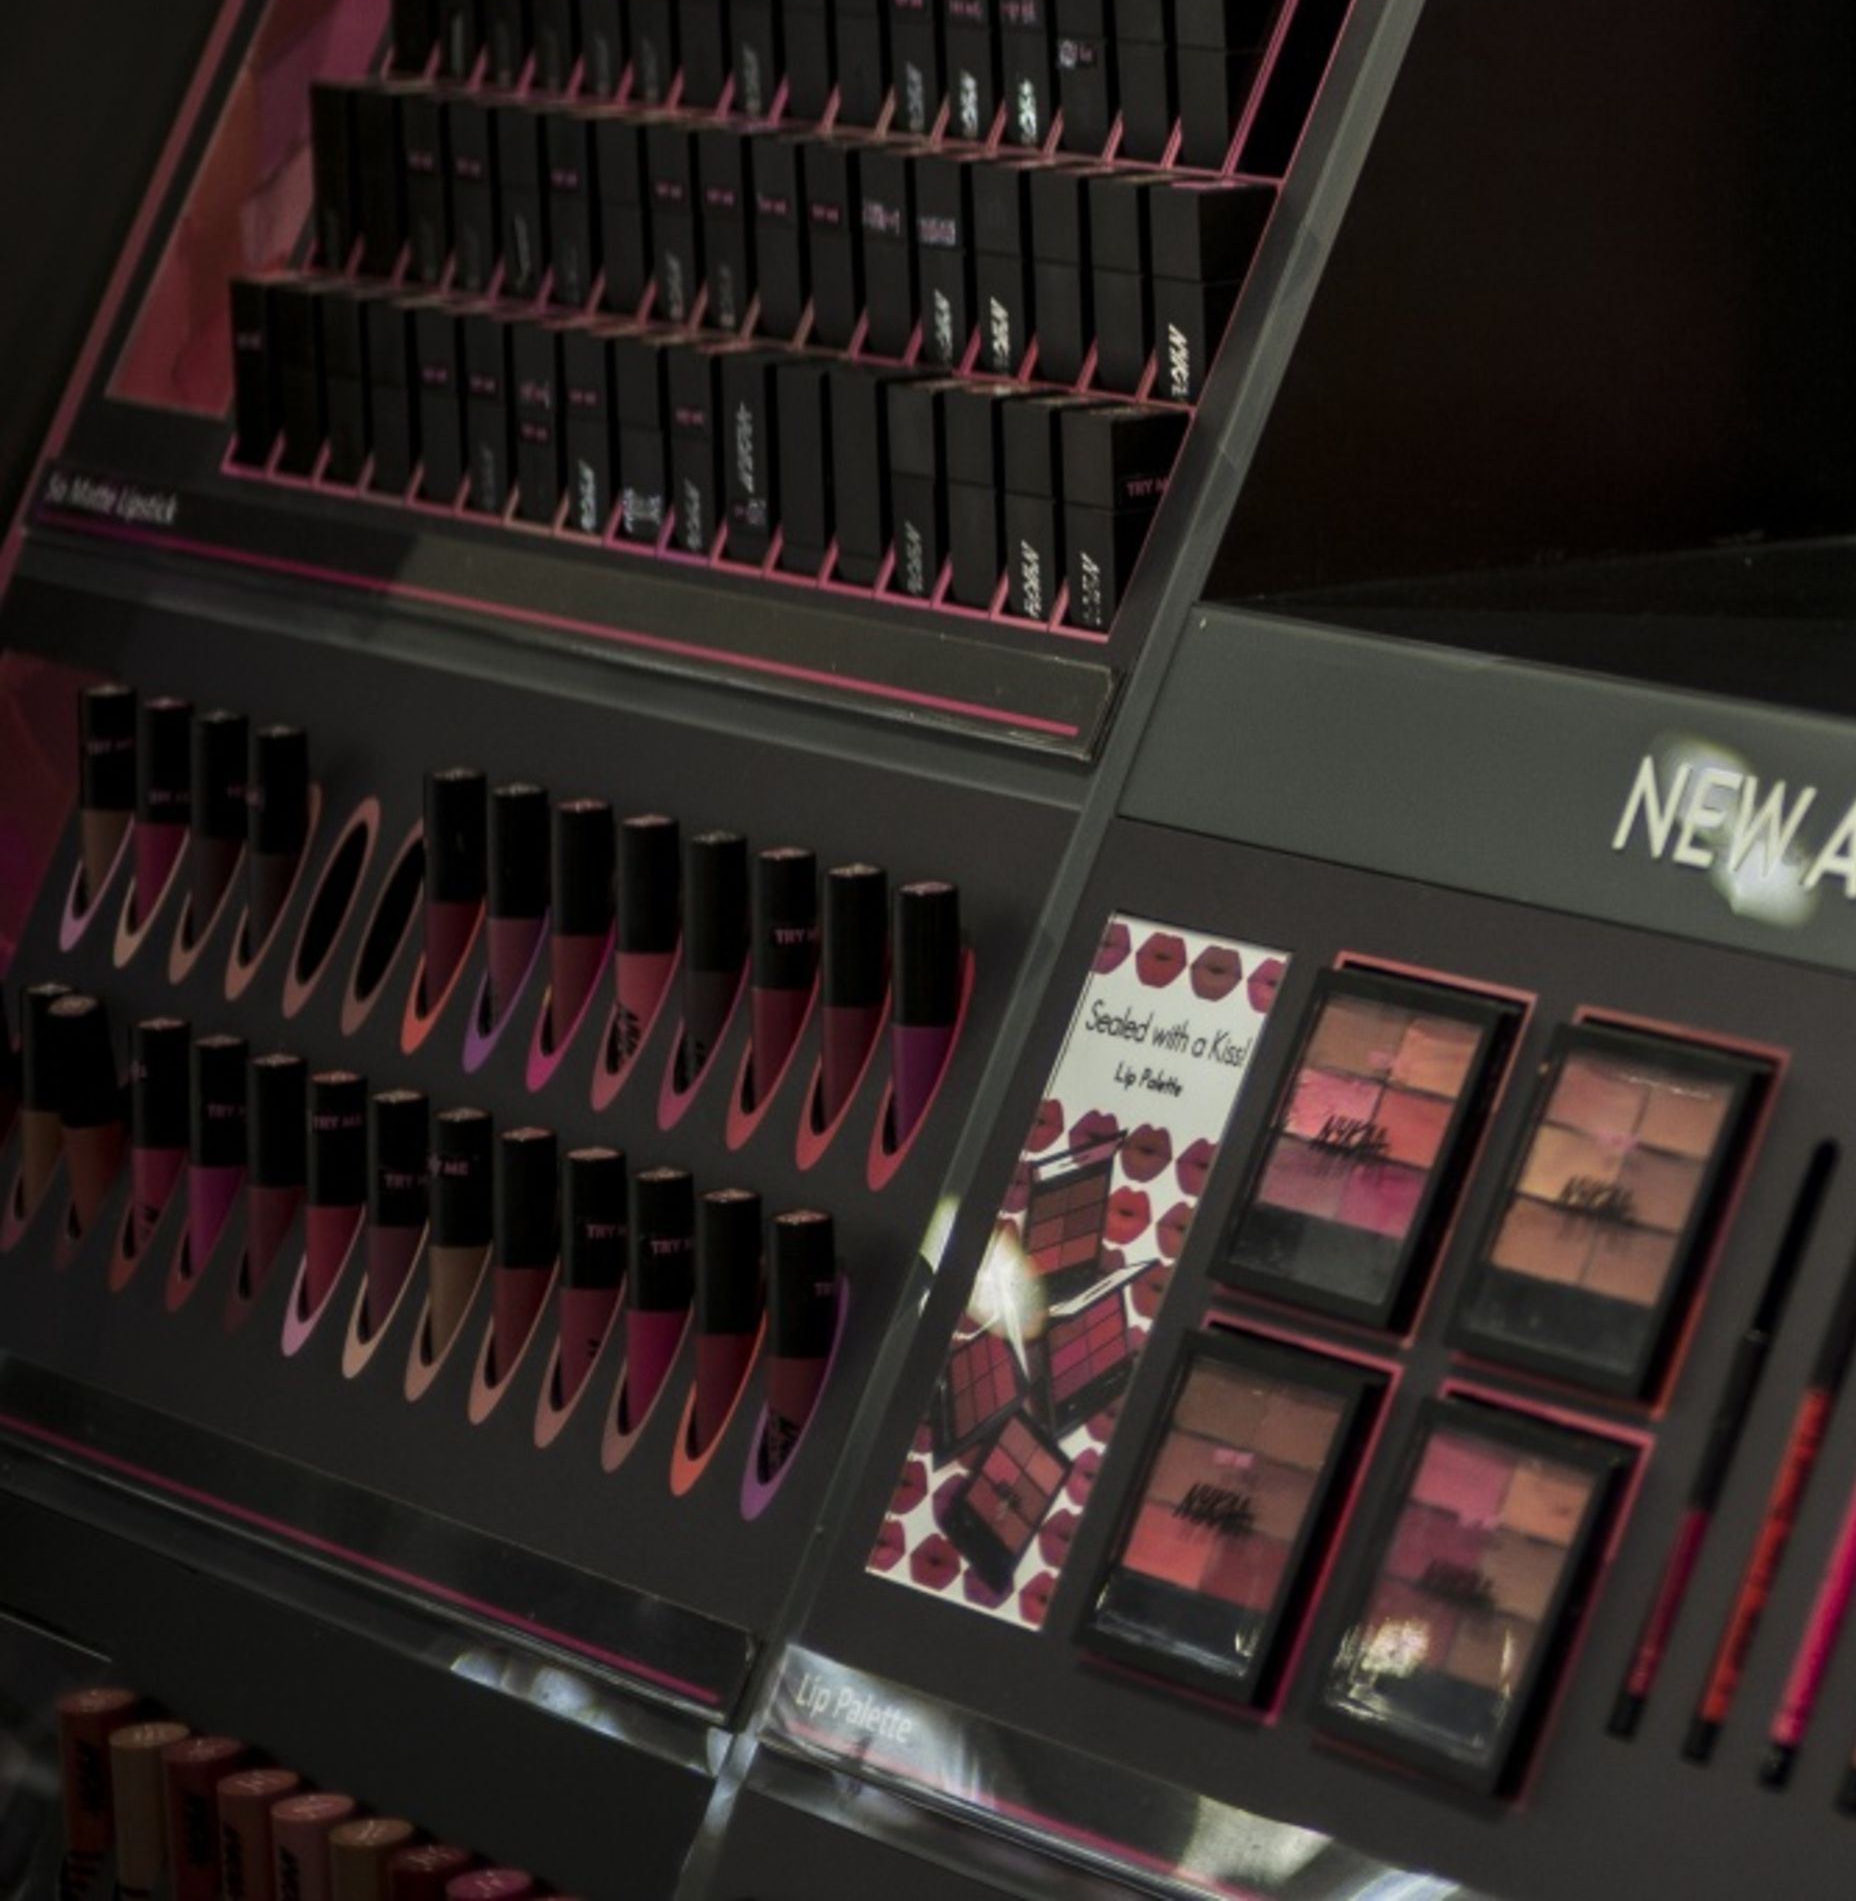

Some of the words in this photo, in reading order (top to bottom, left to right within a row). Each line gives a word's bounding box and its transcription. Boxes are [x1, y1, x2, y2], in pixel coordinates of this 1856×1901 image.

[1611, 755, 1817, 879] NEW
[1085, 998, 1155, 1043] Sealed
[1152, 1018, 1190, 1054] with
[1191, 1037, 1207, 1058] a
[1114, 1060, 1137, 1092] Lip
[1139, 1067, 1184, 1098] Palette
[796, 1673, 831, 1718] Lip
[832, 1686, 912, 1743] Palette
